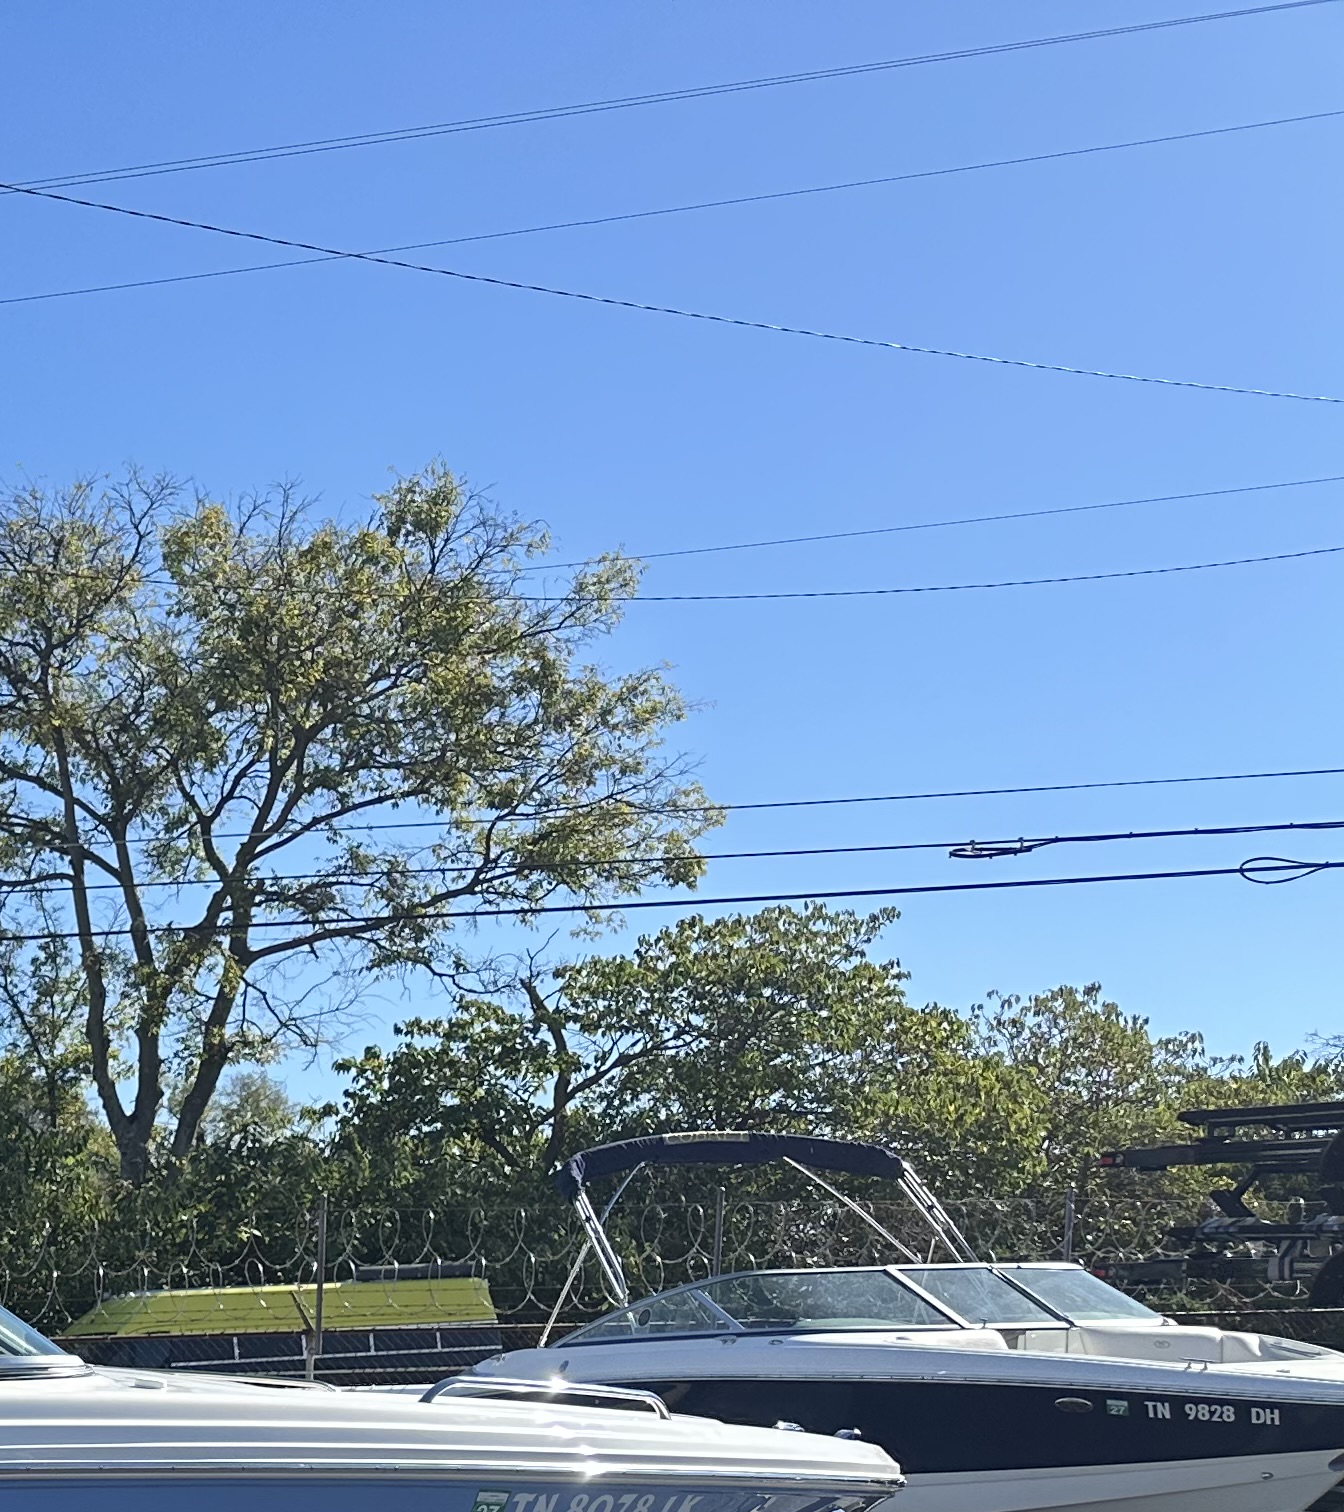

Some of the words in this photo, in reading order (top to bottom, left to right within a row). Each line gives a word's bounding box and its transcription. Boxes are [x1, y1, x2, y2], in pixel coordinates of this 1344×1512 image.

[1109, 1406, 1126, 1415] 27
[1144, 1401, 1172, 1419] TN
[1184, 1403, 1236, 1422] 9828
[1250, 1407, 1281, 1425] DH
